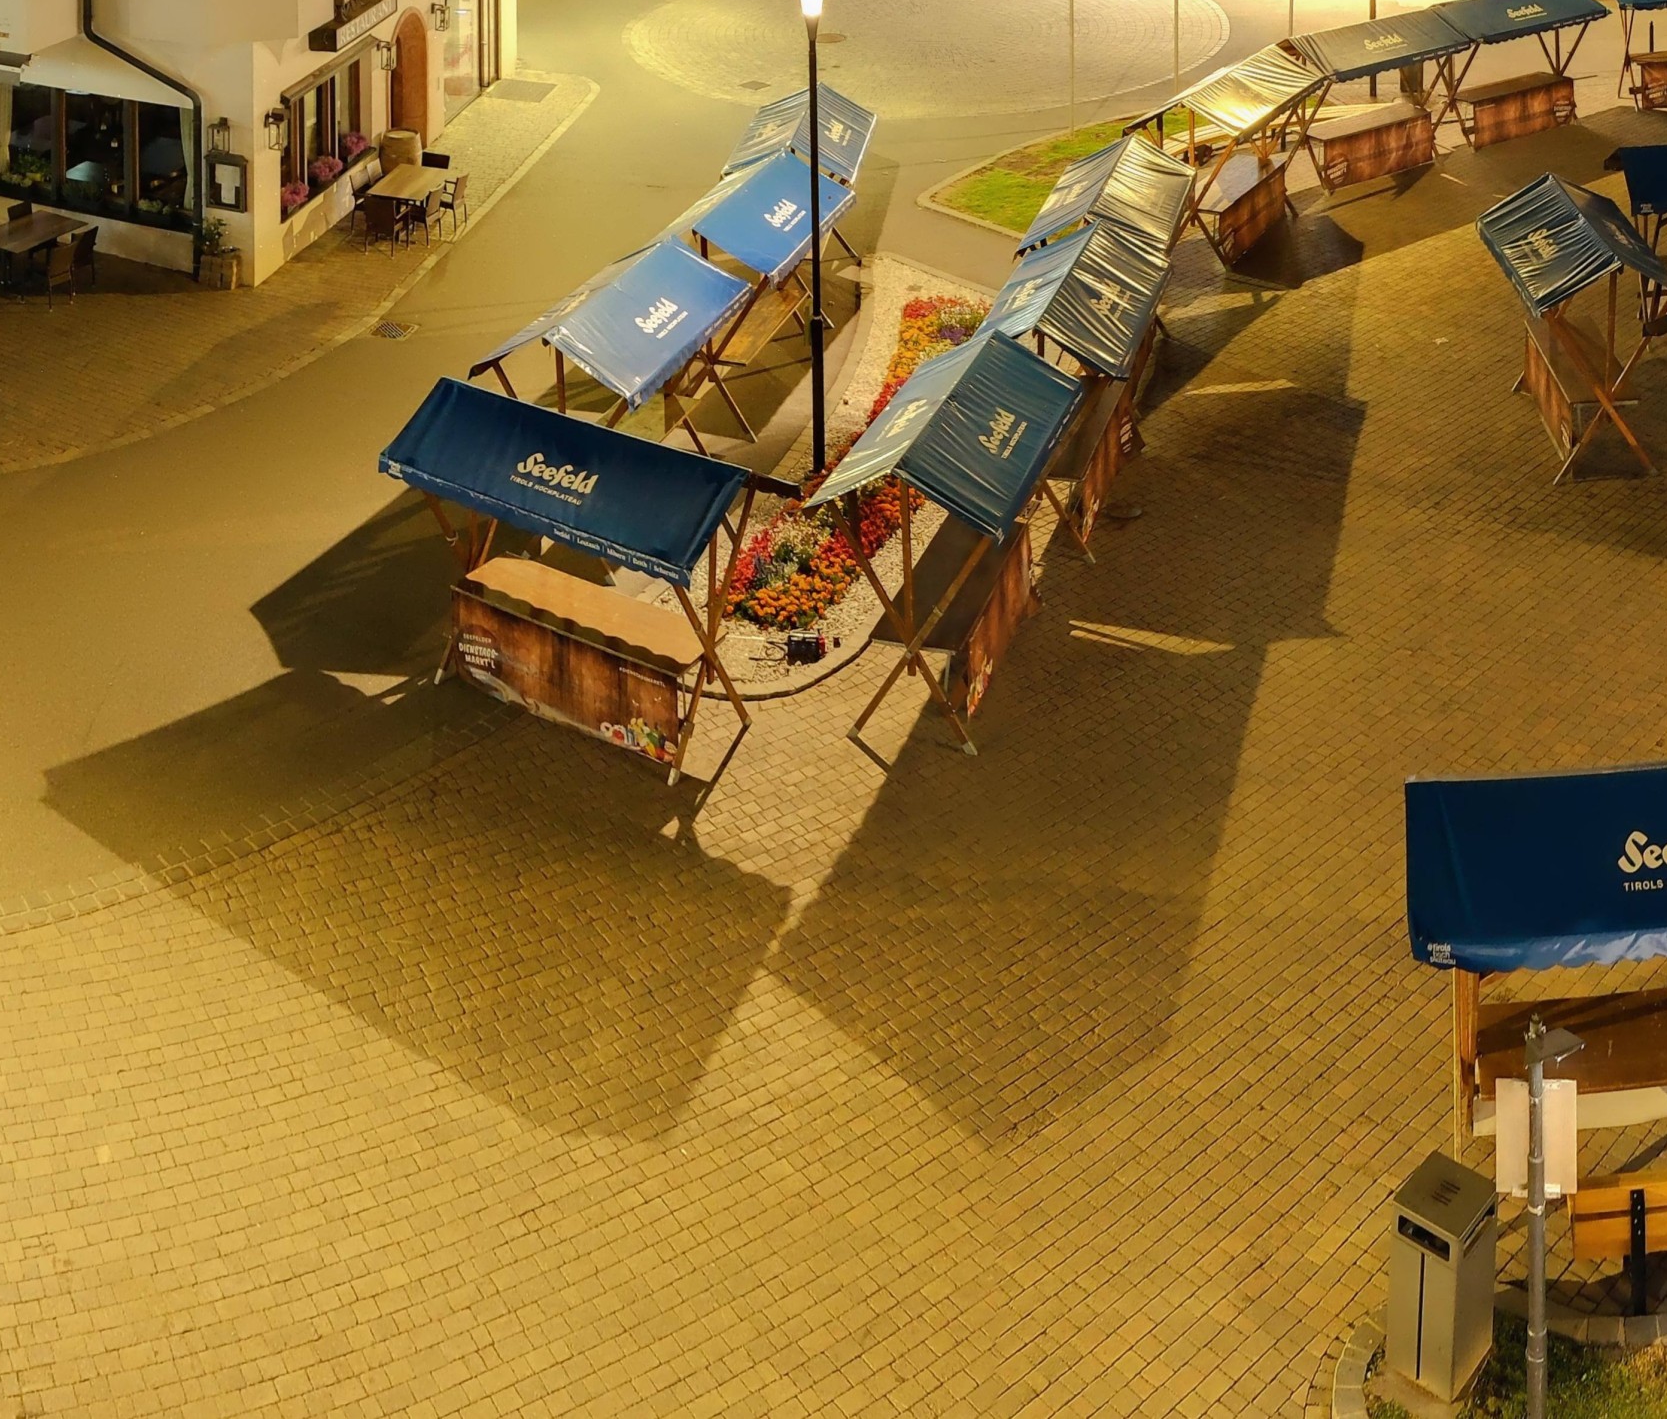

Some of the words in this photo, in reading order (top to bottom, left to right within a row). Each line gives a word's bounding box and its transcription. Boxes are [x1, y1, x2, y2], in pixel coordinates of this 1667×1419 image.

[1506, 3, 1544, 19] Seefeld
[1364, 34, 1403, 51] Seefeld
[763, 198, 798, 228] Seefeld
[634, 296, 679, 334] Seefeld
[978, 406, 1016, 455] Seefeld
[516, 452, 600, 495] Seefeld
[510, 474, 533, 489] TIROLS
[533, 483, 583, 506] HOCHPLATEAU
[458, 641, 499, 659] DIENSTAGS-
[464, 654, 496, 669] MARKT'L
[1623, 877, 1664, 892] TIROLS
